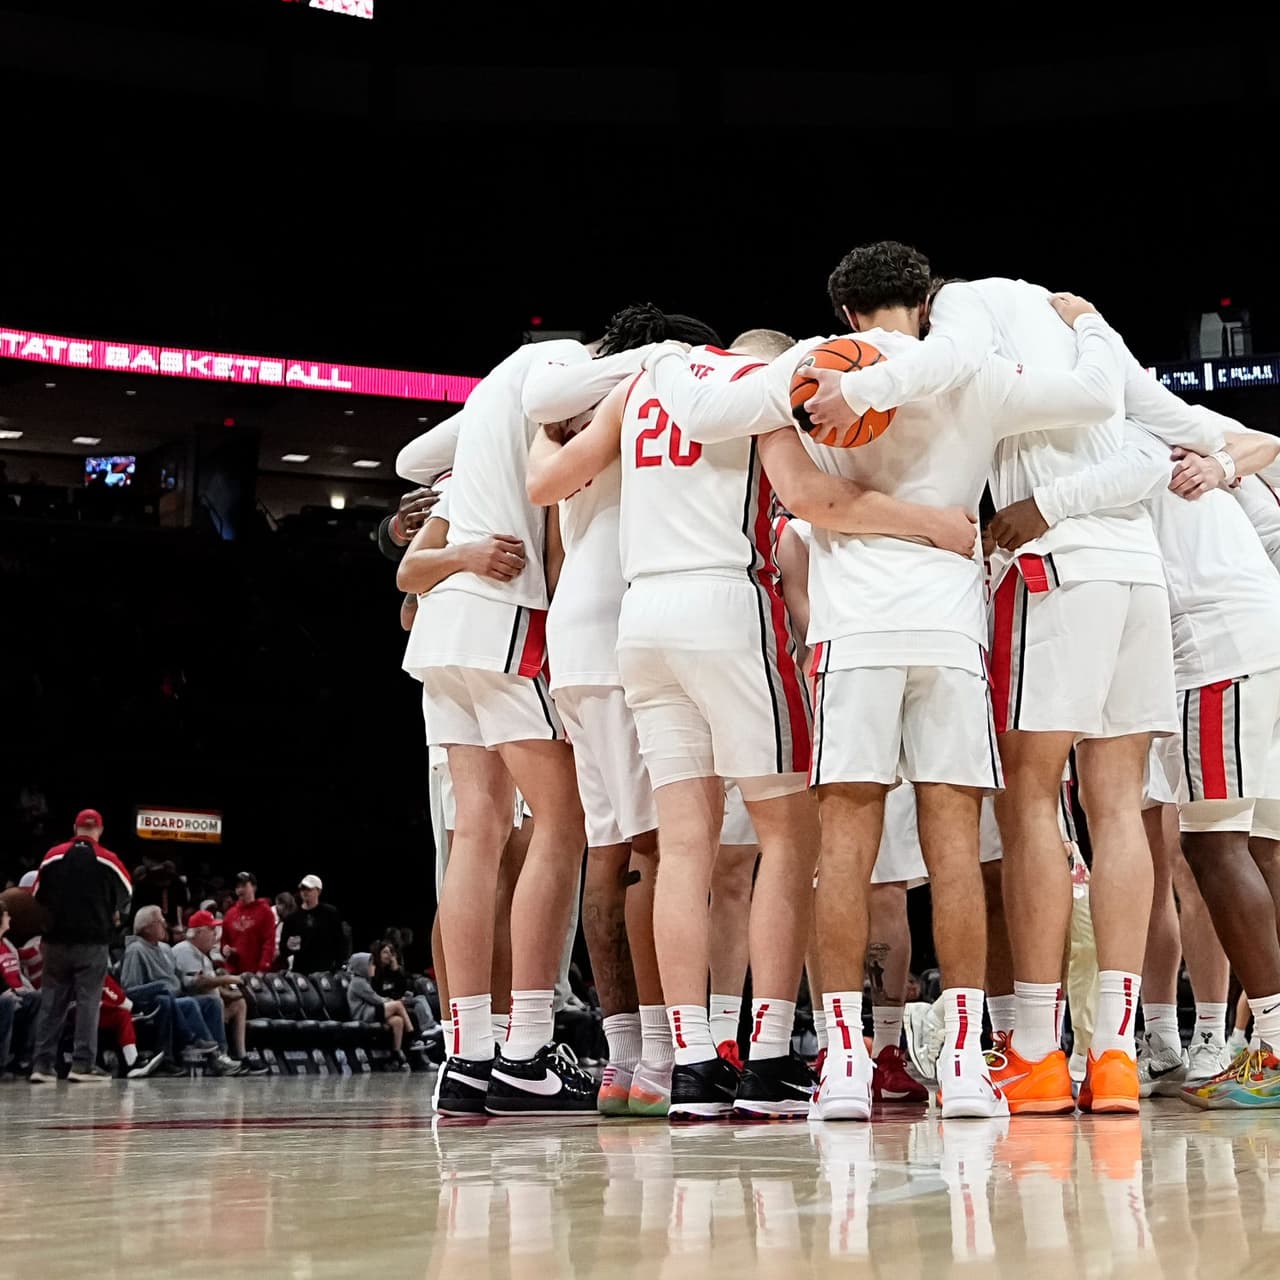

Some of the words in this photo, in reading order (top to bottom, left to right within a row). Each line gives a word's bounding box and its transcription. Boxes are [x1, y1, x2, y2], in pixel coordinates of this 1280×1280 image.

[105, 346, 353, 389] BASKETBALL
[635, 398, 703, 469] 20
[144, 816, 218, 832] BOARDROOM
